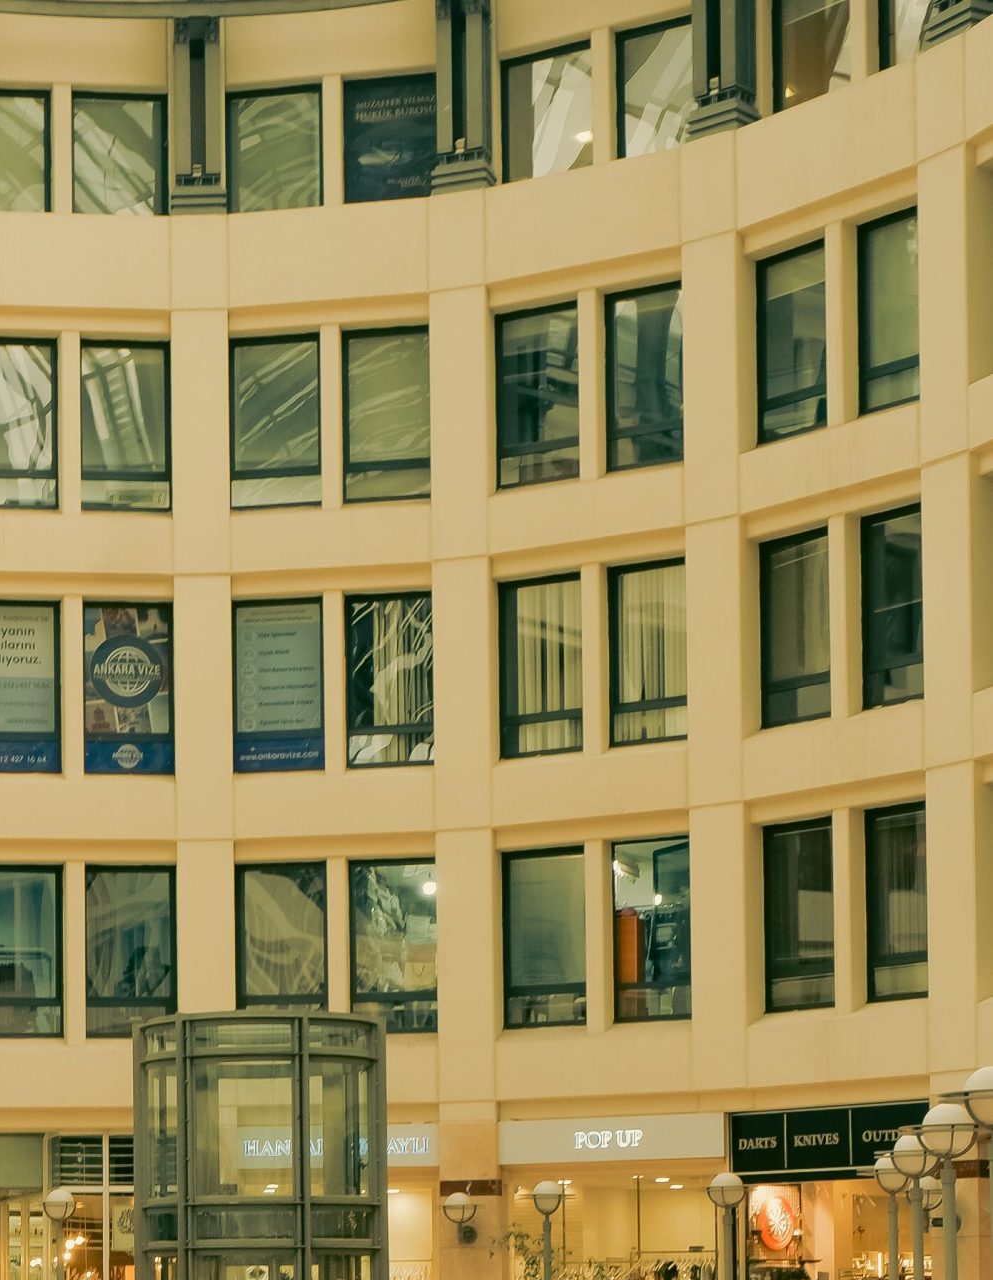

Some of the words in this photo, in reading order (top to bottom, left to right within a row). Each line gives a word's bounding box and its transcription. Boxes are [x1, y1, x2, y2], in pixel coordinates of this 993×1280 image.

[93, 663, 136, 675] ANKARA
[573, 1130, 613, 1149] POP
[615, 1129, 644, 1148] UP
[738, 1136, 778, 1151] DARTS
[793, 1132, 840, 1147] KNIVES
